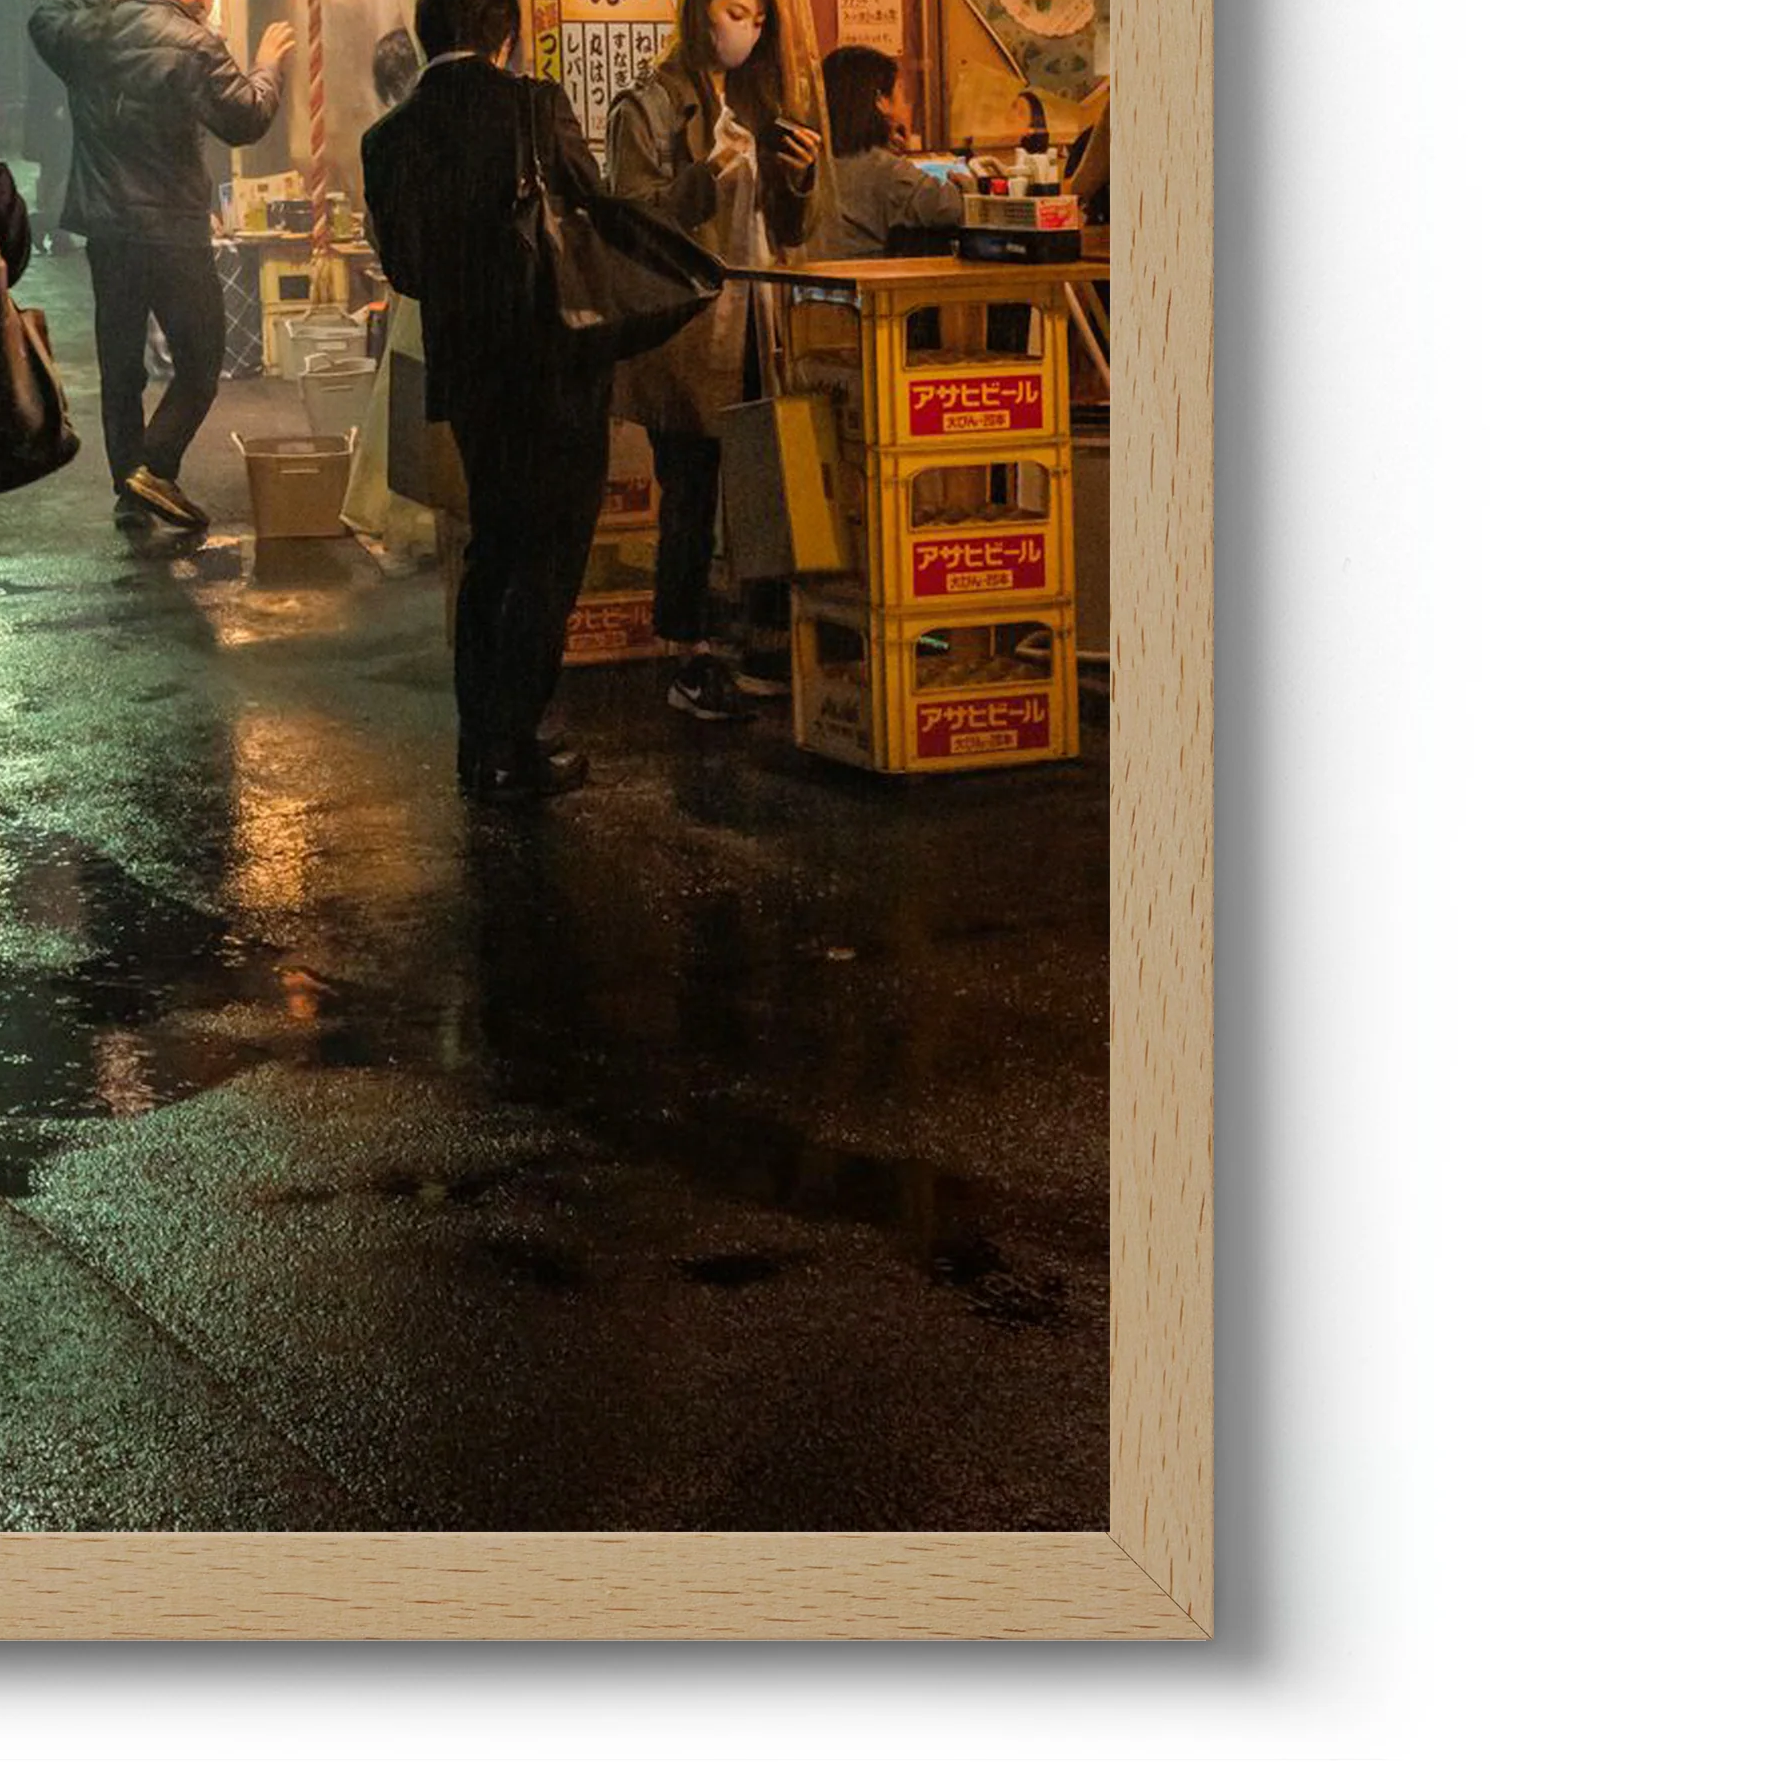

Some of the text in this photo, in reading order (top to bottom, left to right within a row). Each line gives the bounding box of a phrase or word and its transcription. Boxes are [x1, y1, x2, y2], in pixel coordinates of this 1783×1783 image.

[567, 33, 582, 104] レバー
[912, 380, 1039, 411] アサヒビール
[916, 538, 1042, 571] アサヒビール
[920, 698, 1046, 733] アサヒビール
